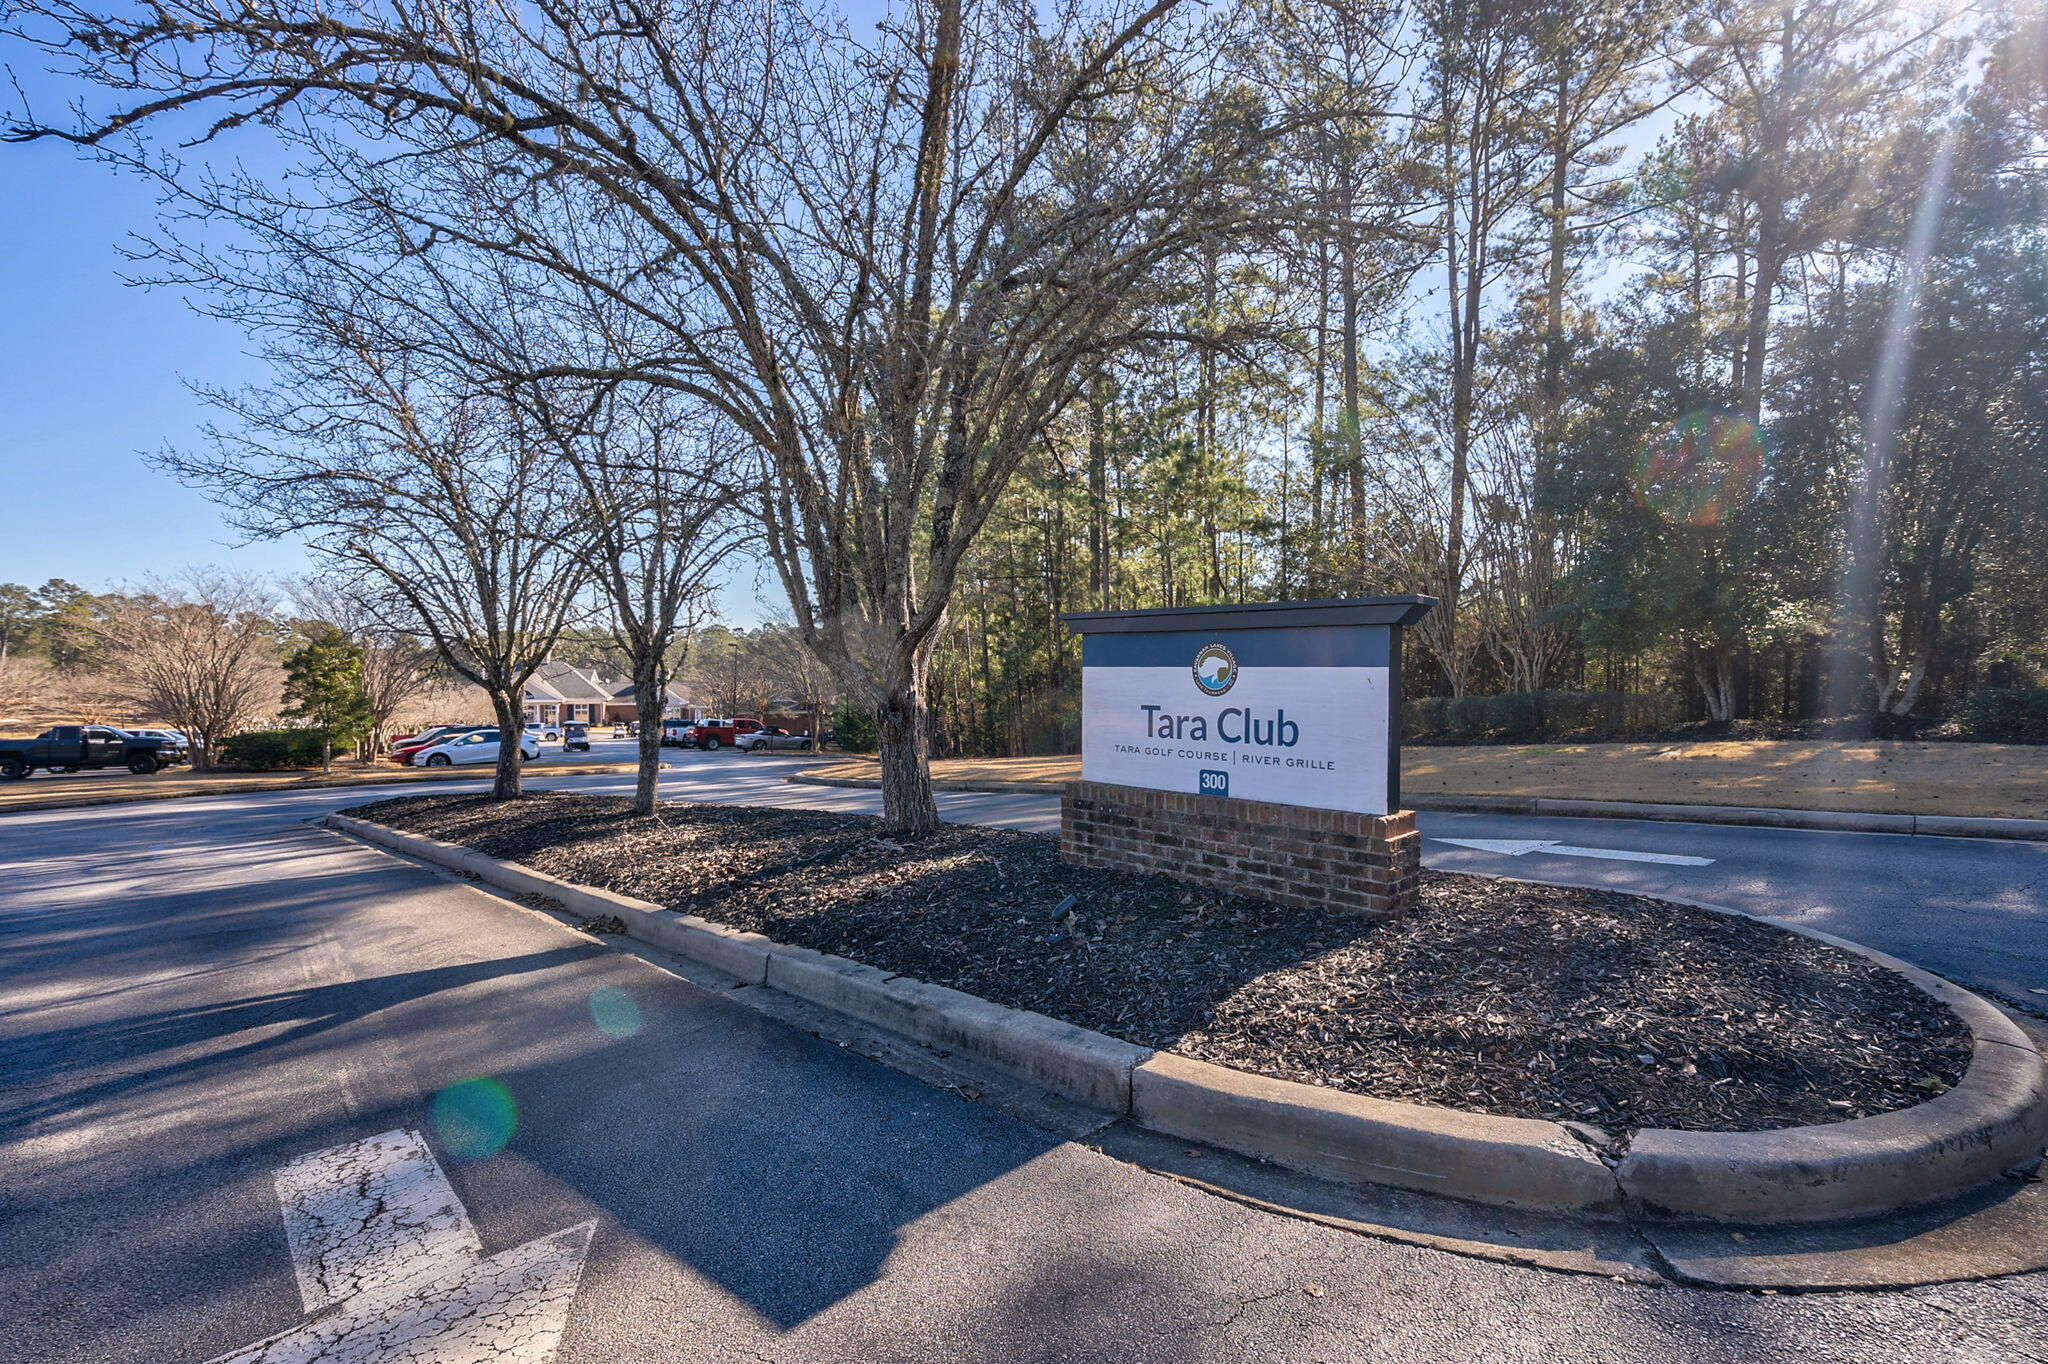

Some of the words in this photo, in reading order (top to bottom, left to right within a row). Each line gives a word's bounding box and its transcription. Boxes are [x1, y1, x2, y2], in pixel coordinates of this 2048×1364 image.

[1210, 643, 1227, 651] LAKES
[1141, 704, 1207, 741] Tara
[1217, 707, 1299, 747] Club
[1114, 744, 1141, 754] TARA
[1144, 746, 1174, 758] GOLF
[1177, 749, 1228, 762] COURSE
[1242, 754, 1281, 767] RIVER
[1285, 758, 1336, 771] GRILLE
[1202, 773, 1226, 790] 300
